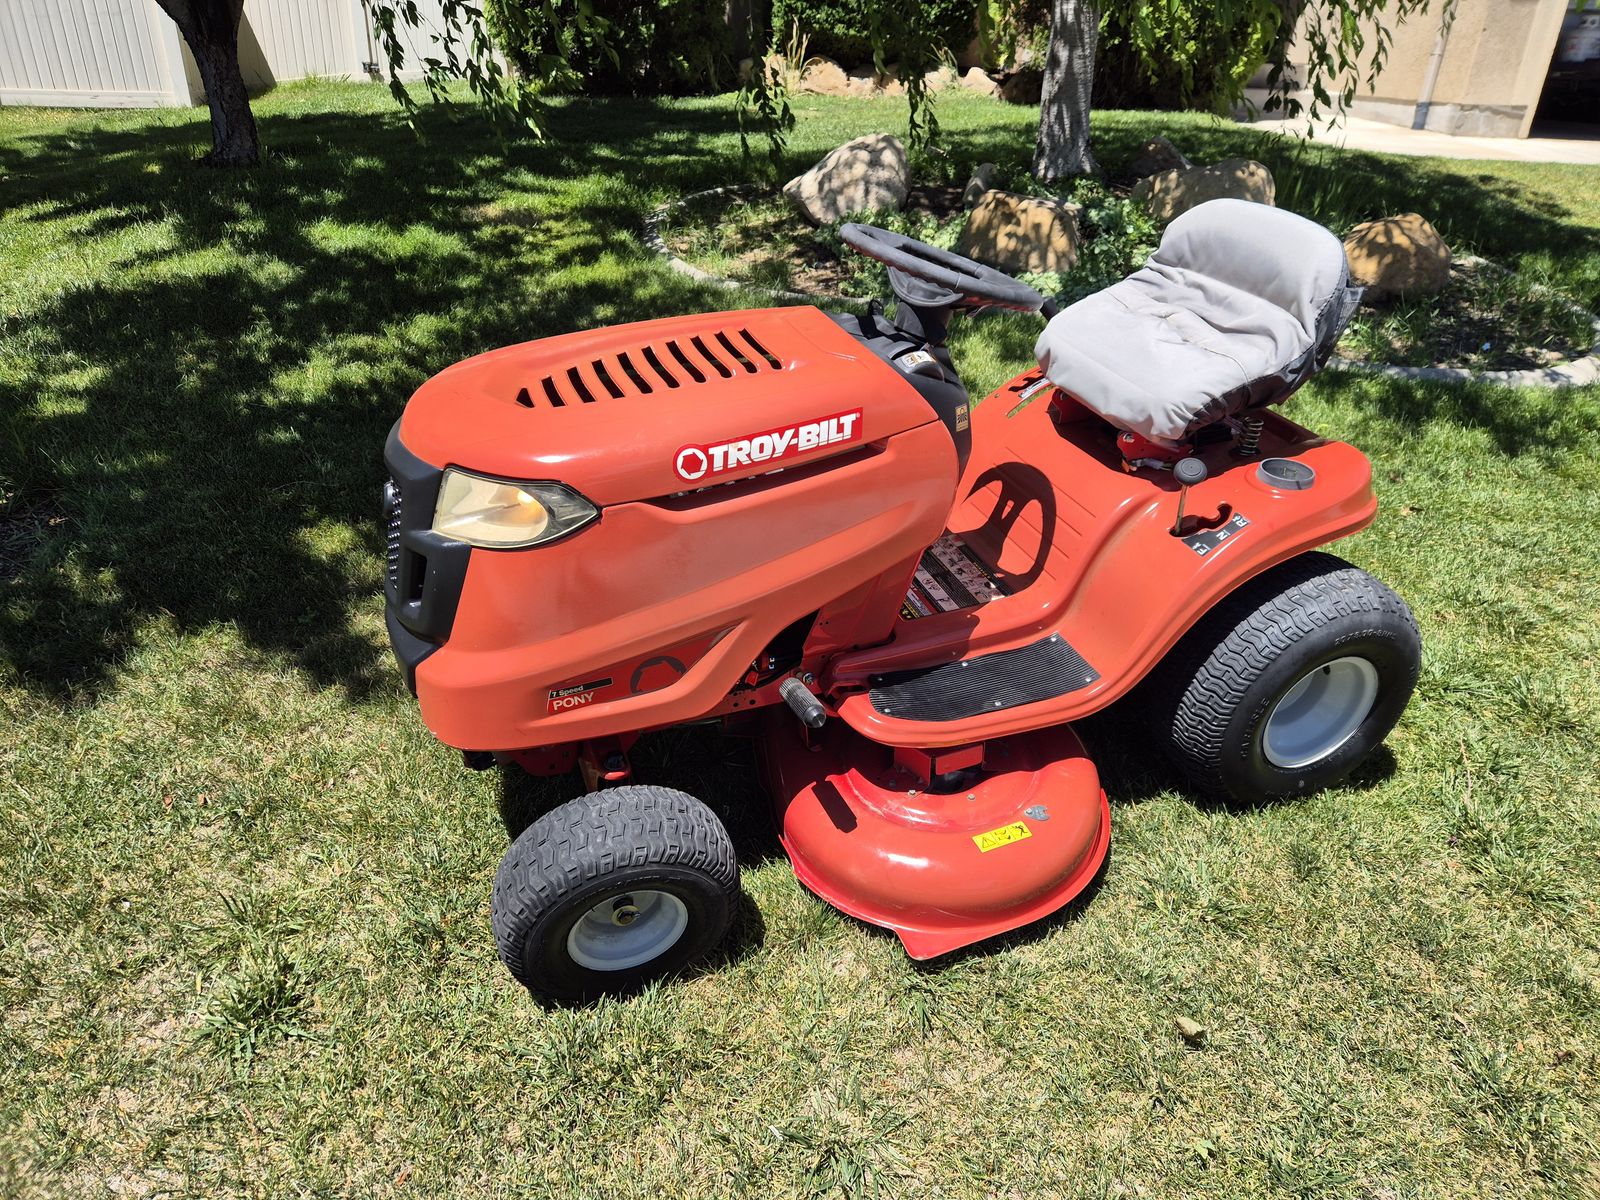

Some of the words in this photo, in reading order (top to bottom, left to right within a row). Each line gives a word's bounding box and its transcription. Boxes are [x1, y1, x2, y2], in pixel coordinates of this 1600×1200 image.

[708, 412, 857, 472] TROY-BILT
[1216, 531, 1228, 540] N
[559, 685, 584, 696] Speed
[552, 692, 594, 710] PONY
